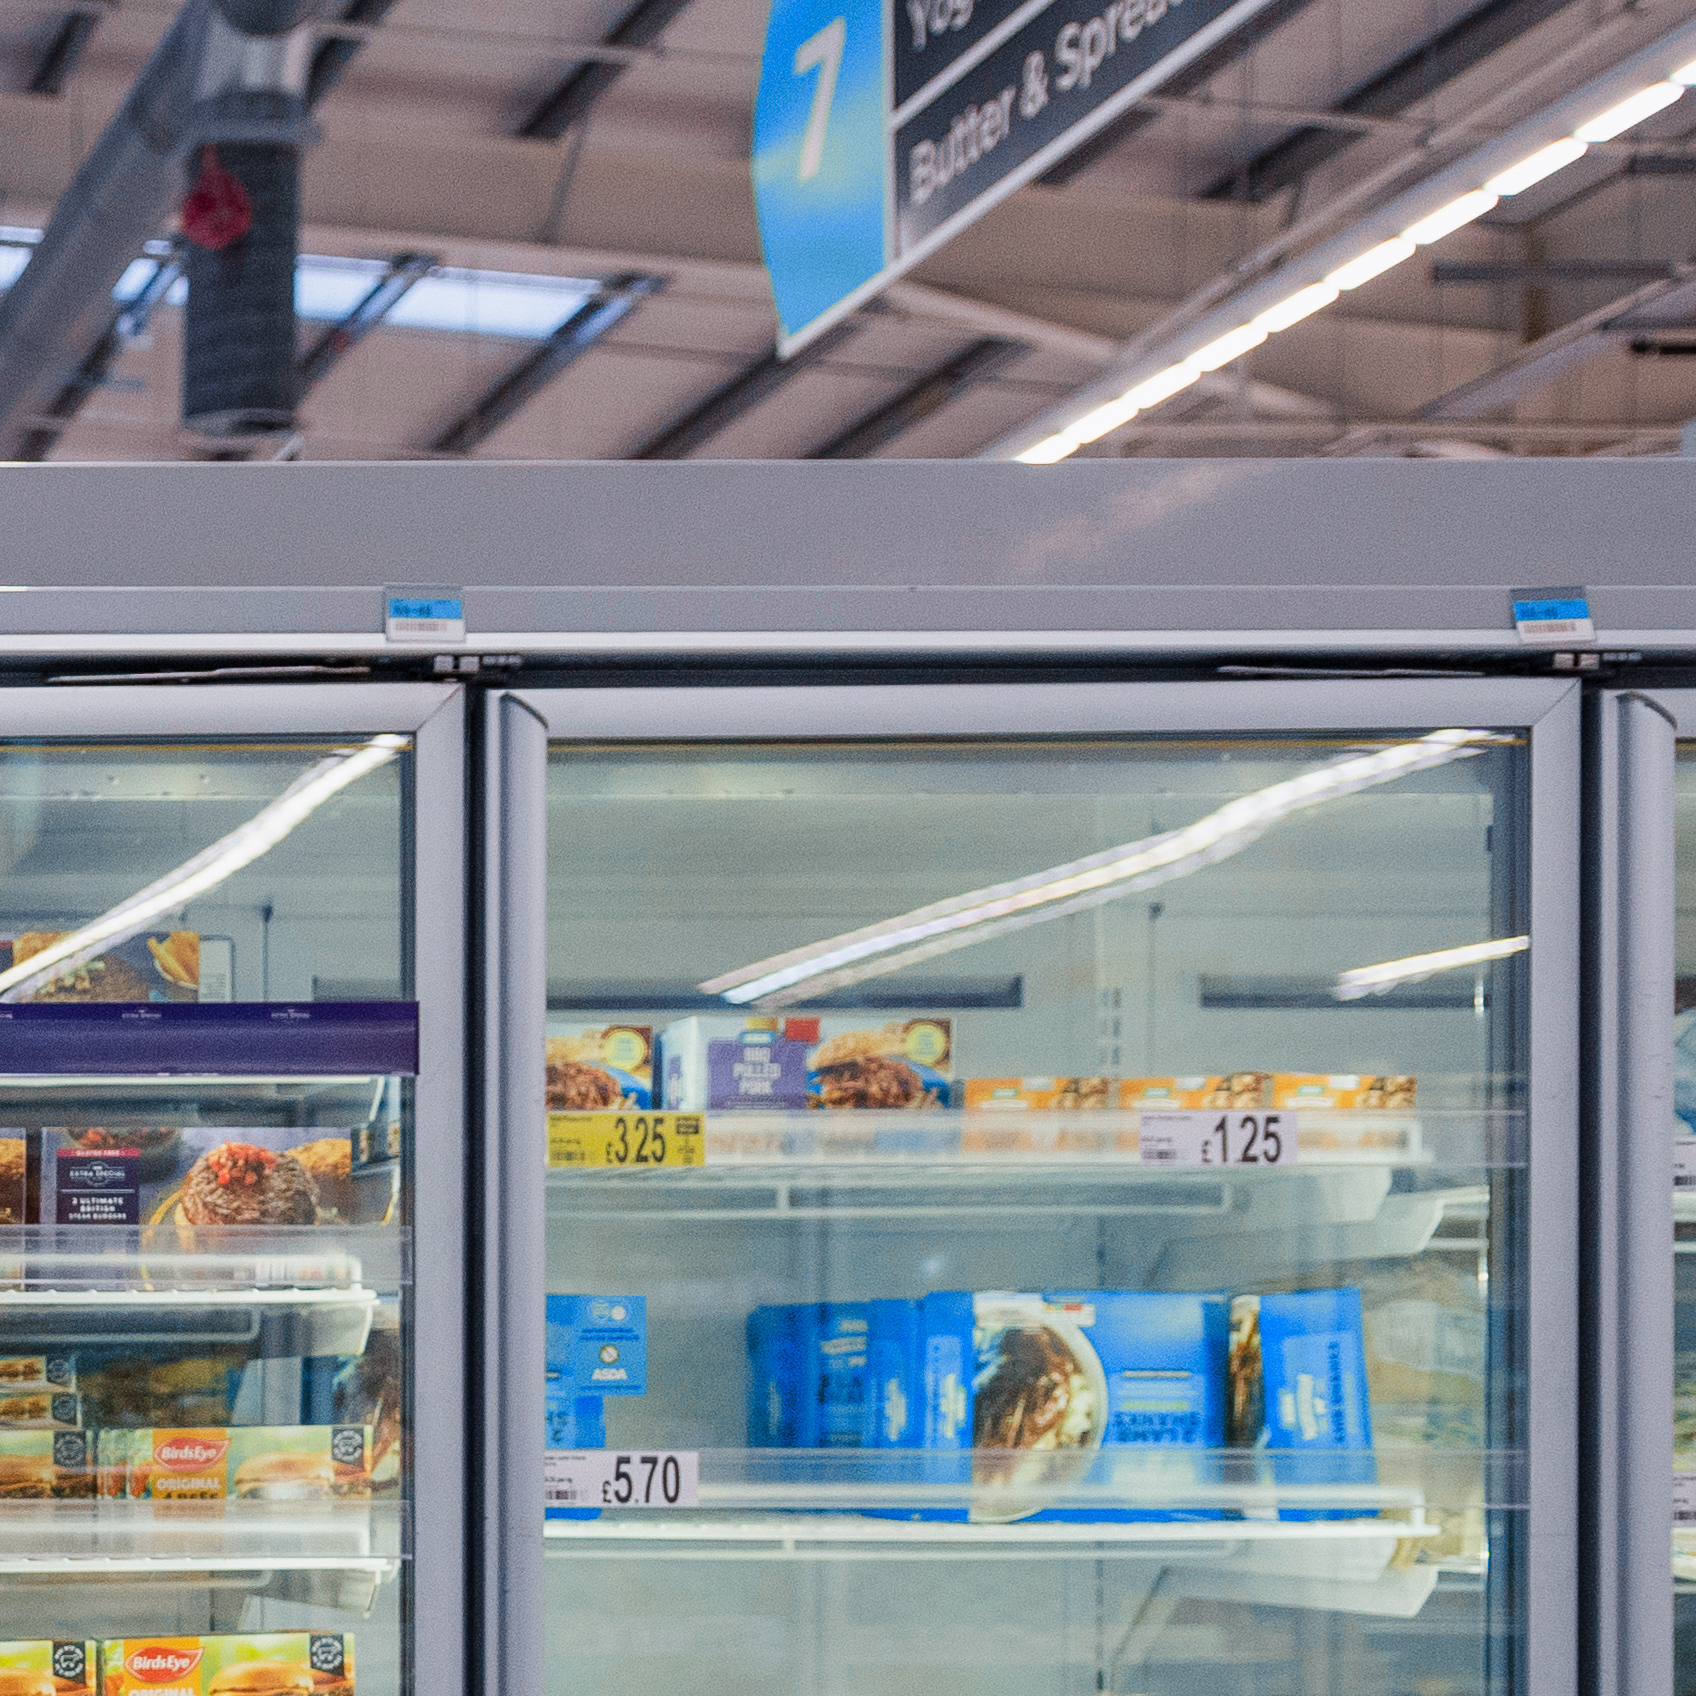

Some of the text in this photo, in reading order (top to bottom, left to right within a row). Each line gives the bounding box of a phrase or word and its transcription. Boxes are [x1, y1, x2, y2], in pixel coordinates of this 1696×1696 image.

[795, 19, 847, 182] 7
[908, 49, 1050, 205] Butter &
[732, 1062, 781, 1080] PULLED
[156, 1478, 221, 1491] ORIGINAL
[602, 1455, 681, 1504] £5.70
